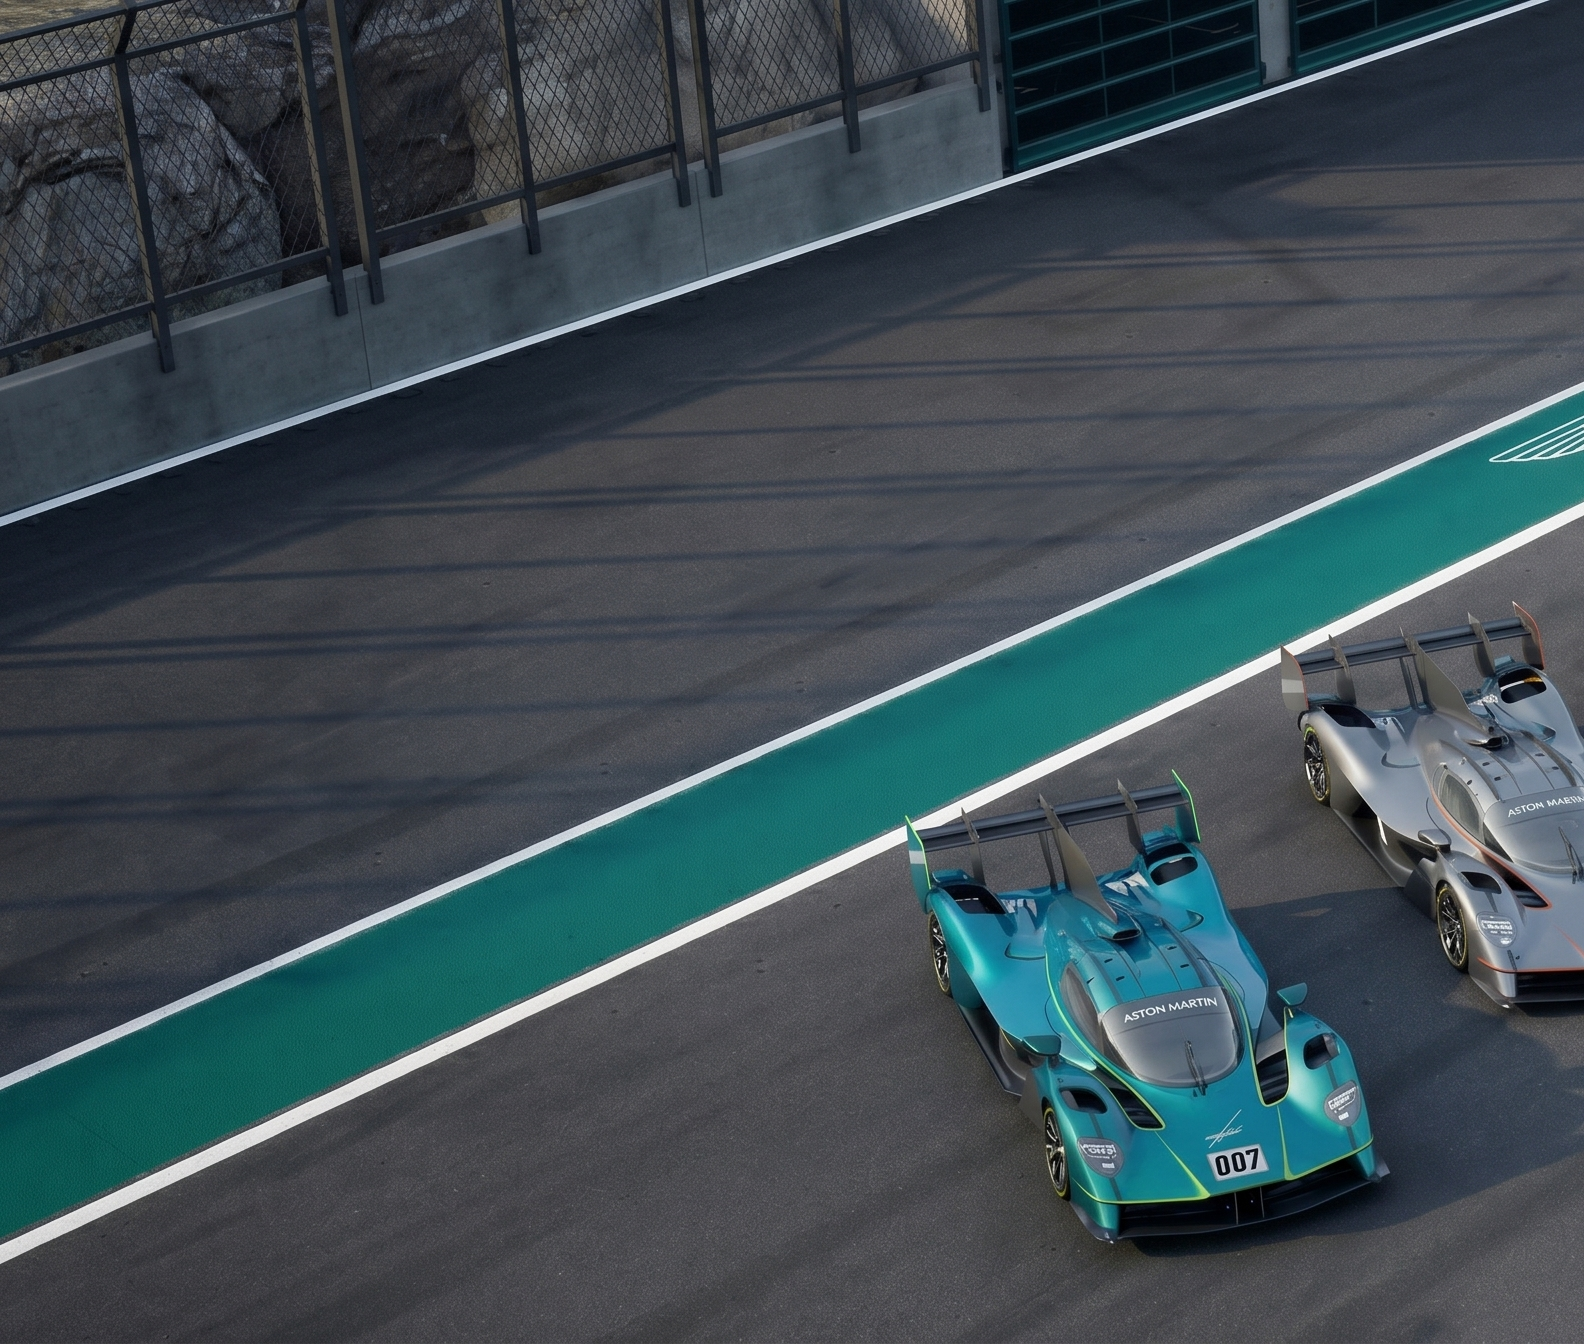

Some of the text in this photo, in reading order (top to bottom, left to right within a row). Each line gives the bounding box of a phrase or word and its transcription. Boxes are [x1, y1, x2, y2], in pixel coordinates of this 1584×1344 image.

[1507, 802, 1545, 818] ASTON
[1124, 997, 1218, 1024] ASTON MARTIN
[1215, 1147, 1259, 1177] 007
